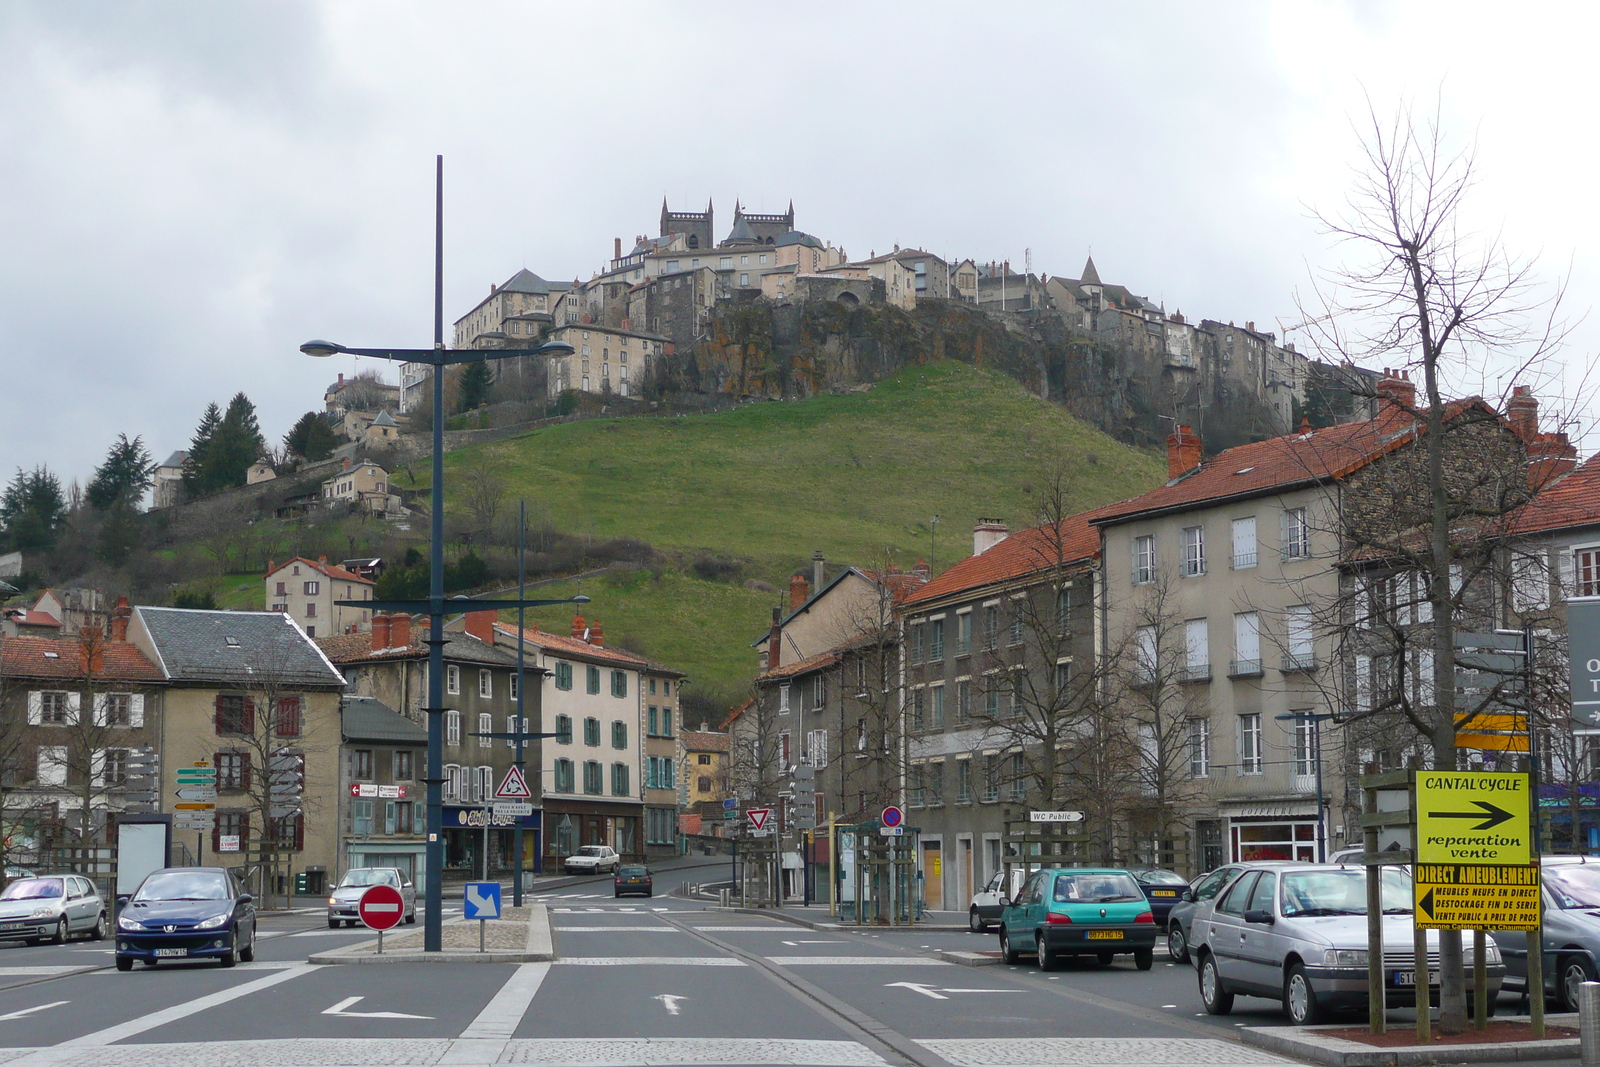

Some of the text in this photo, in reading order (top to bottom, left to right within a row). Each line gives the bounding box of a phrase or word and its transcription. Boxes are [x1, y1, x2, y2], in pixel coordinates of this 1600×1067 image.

[1425, 777, 1522, 792] CANTAL'CYCLE
[1242, 807, 1294, 815] COIFFURE
[1427, 834, 1522, 848] reparation
[1450, 848, 1498, 858] vente
[1417, 865, 1537, 884] DIRECT AMEUBLEMENT
[1435, 887, 1537, 898] MEUBLES NEUFS EN DIRECT
[1435, 900, 1537, 910] DESTOCKAGE FIN DE SERIE
[1435, 912, 1456, 920] VENTE
[1458, 913, 1481, 921] PUBLIC
[1483, 913, 1488, 921] A
[1490, 913, 1507, 921] PRIX
[1519, 914, 1537, 922] PROS
